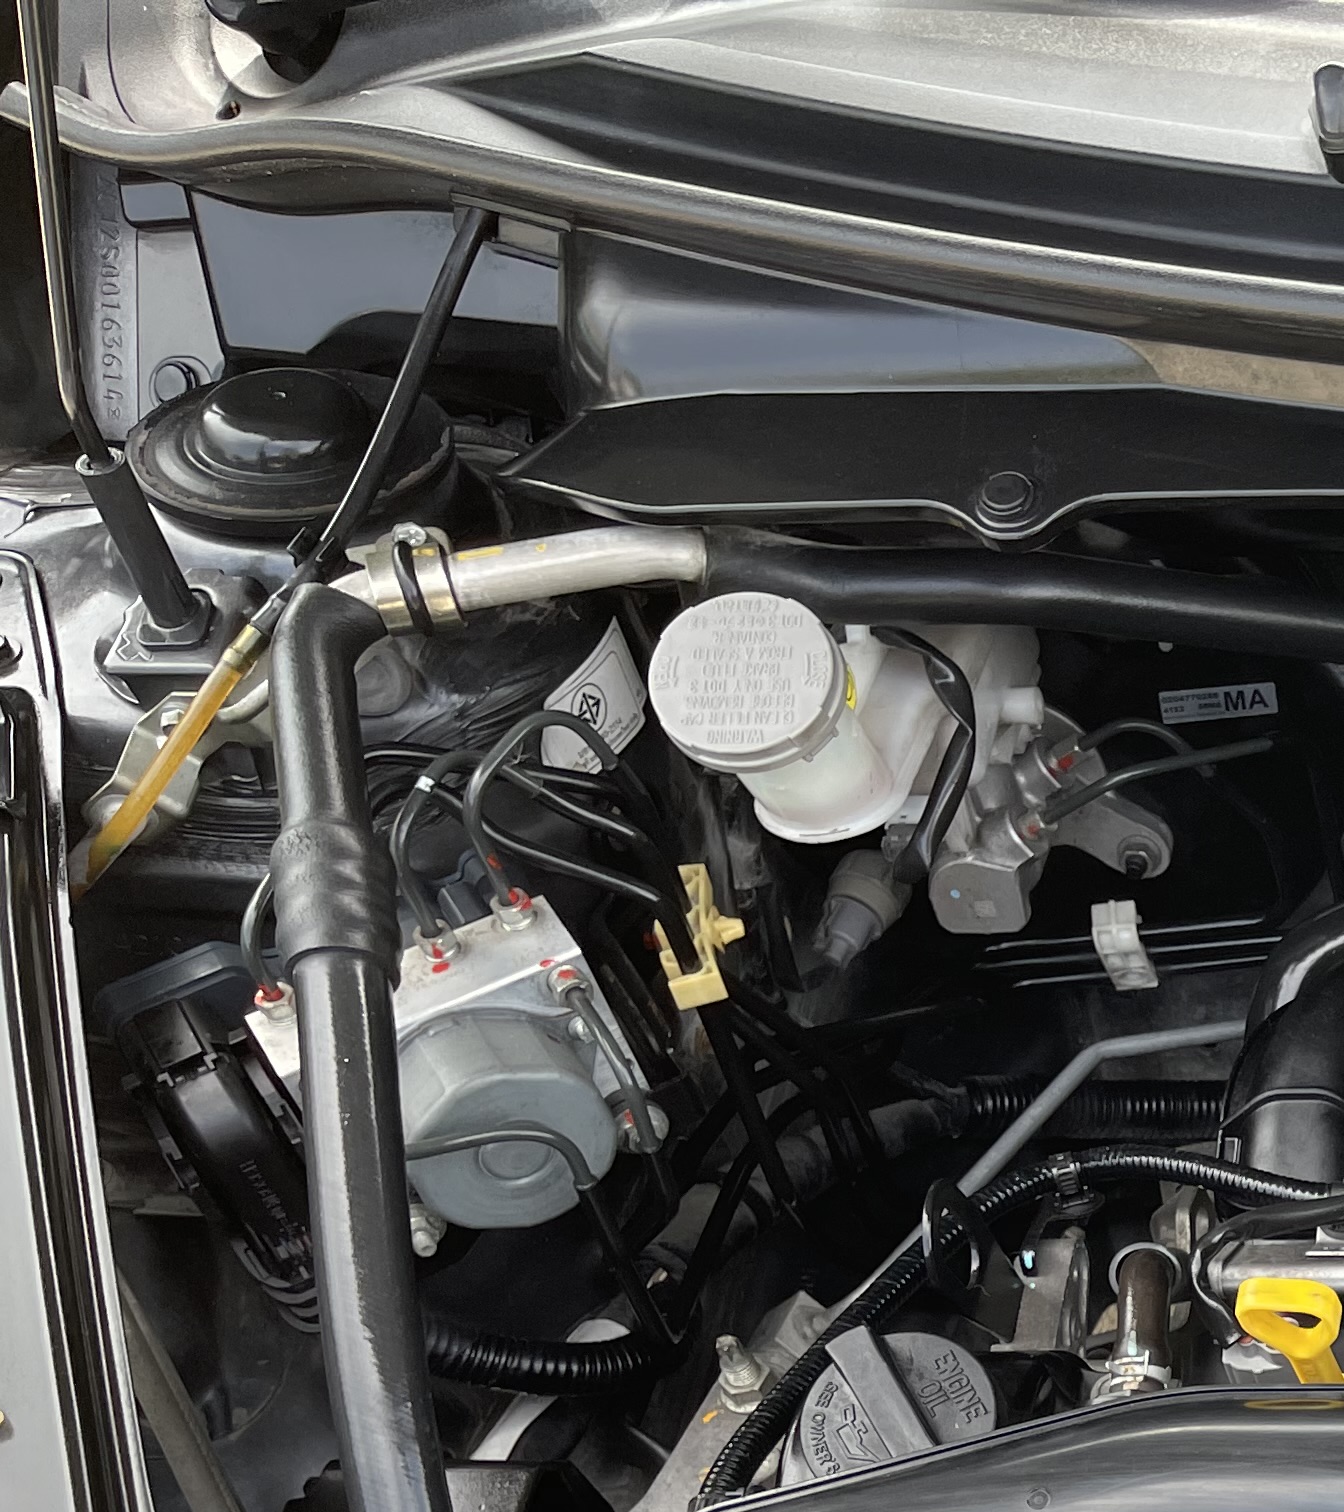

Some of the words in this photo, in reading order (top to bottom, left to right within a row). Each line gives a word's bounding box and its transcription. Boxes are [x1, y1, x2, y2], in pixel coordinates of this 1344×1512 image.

[1223, 688, 1270, 712] MA
[815, 1381, 839, 1409] SEE
[918, 1379, 950, 1419] OIL
[934, 1349, 990, 1424] ENGINE
